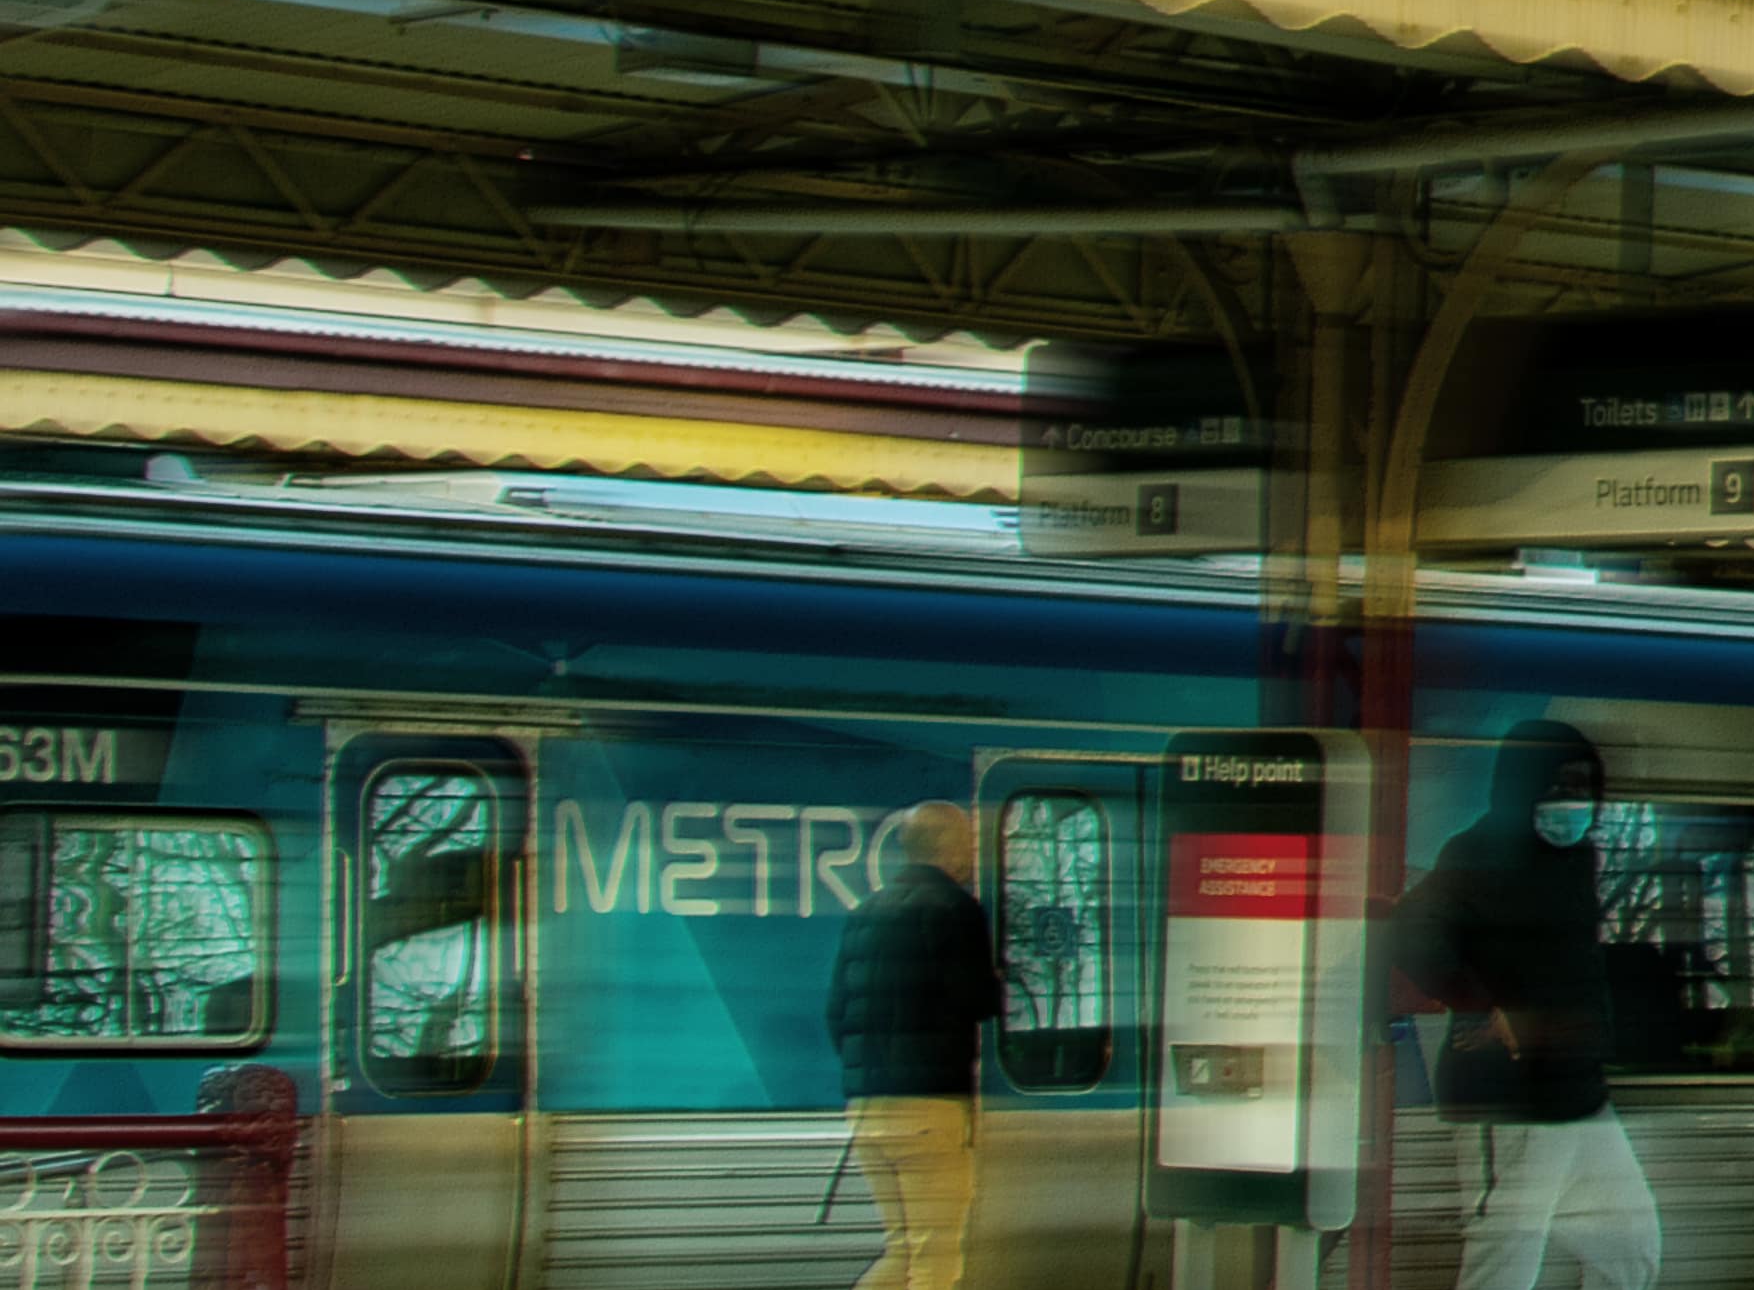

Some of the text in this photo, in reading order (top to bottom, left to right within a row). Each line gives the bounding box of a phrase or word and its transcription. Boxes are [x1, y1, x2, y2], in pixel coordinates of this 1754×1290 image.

[1580, 397, 1658, 427] Toilets
[1067, 423, 1177, 450] Concourse
[1596, 473, 1742, 507] Platform 9
[1040, 496, 1165, 527] Platform 8
[1204, 755, 1303, 787] Help point
[1200, 858, 1276, 874] EMERGENCY
[1199, 880, 1276, 897] ASSISTANCE
